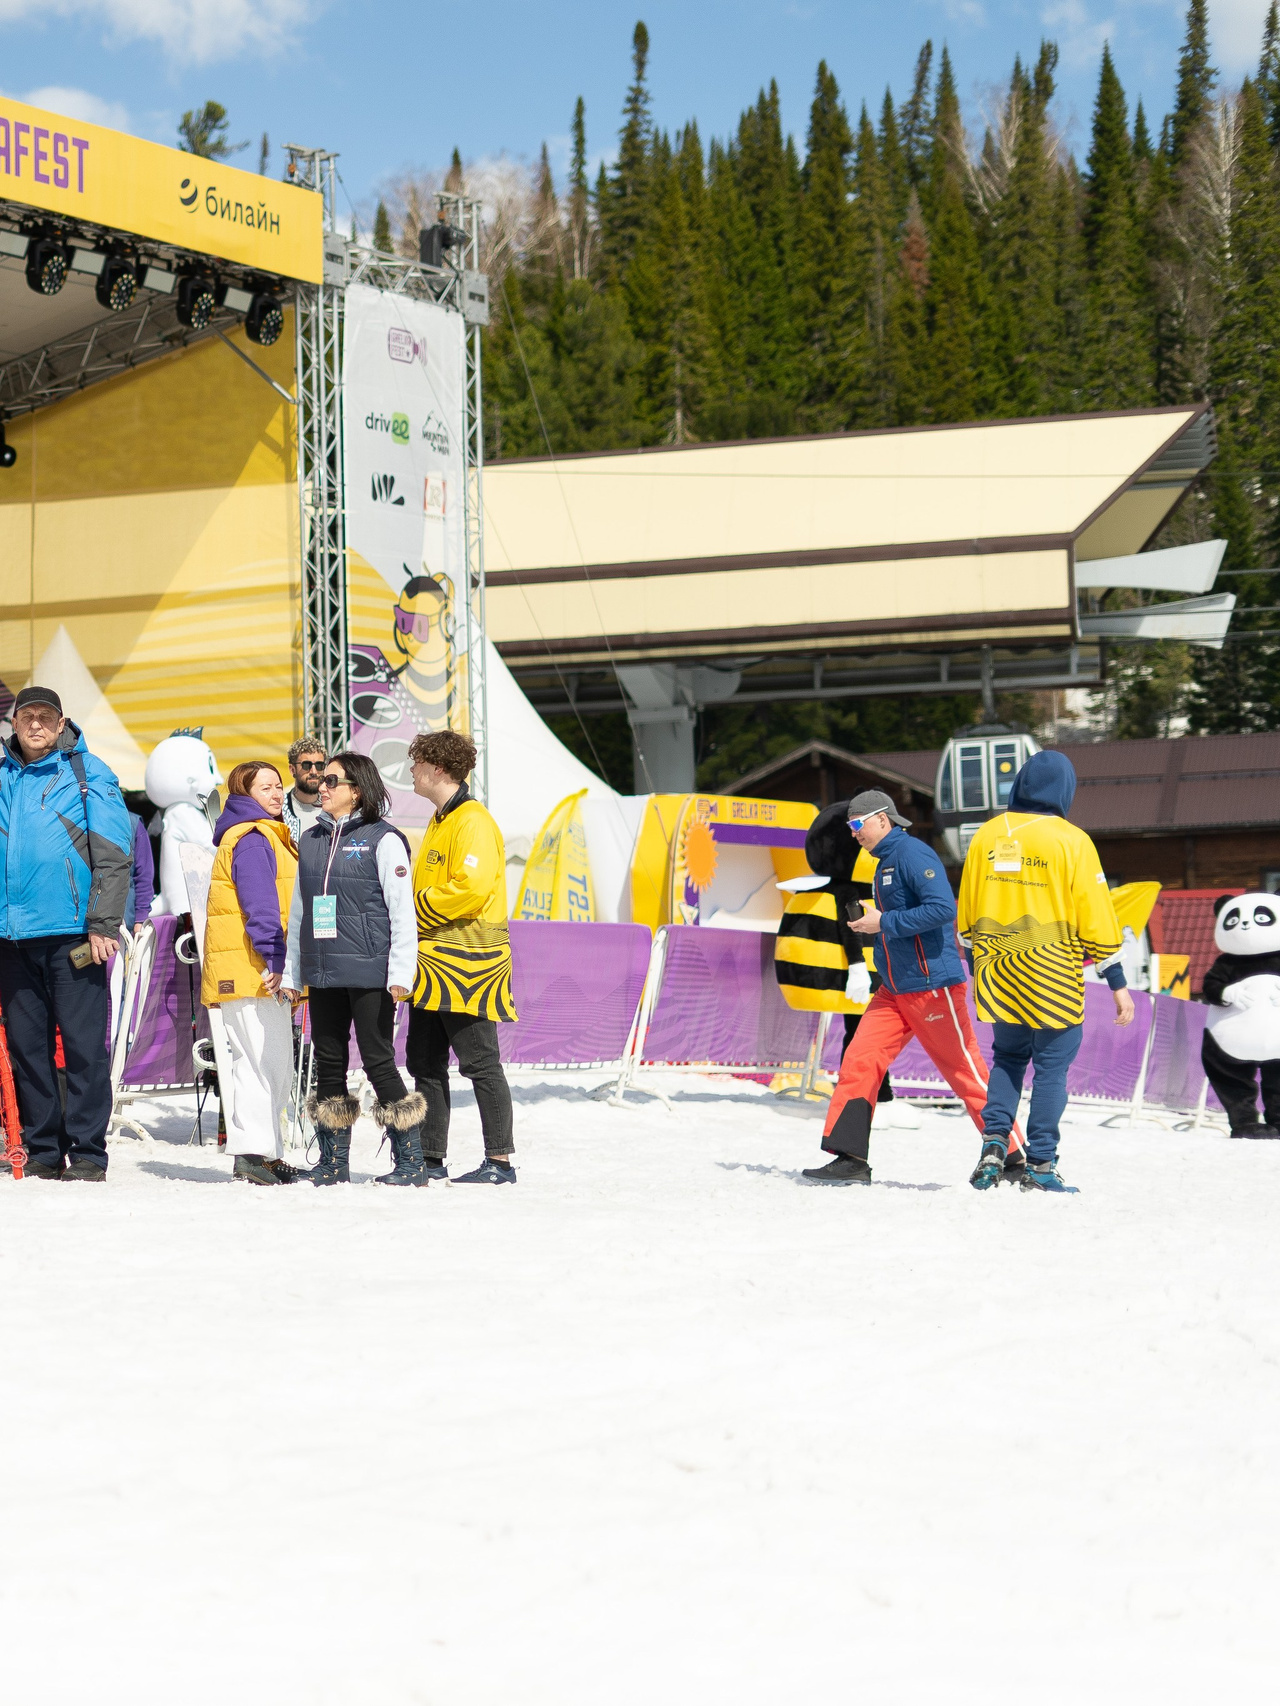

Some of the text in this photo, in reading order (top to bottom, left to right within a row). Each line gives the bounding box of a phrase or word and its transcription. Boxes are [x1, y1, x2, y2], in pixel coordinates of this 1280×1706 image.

[205, 186, 280, 235] билайн
[365, 412, 409, 440] drivee
[1020, 855, 1049, 869] лайн
